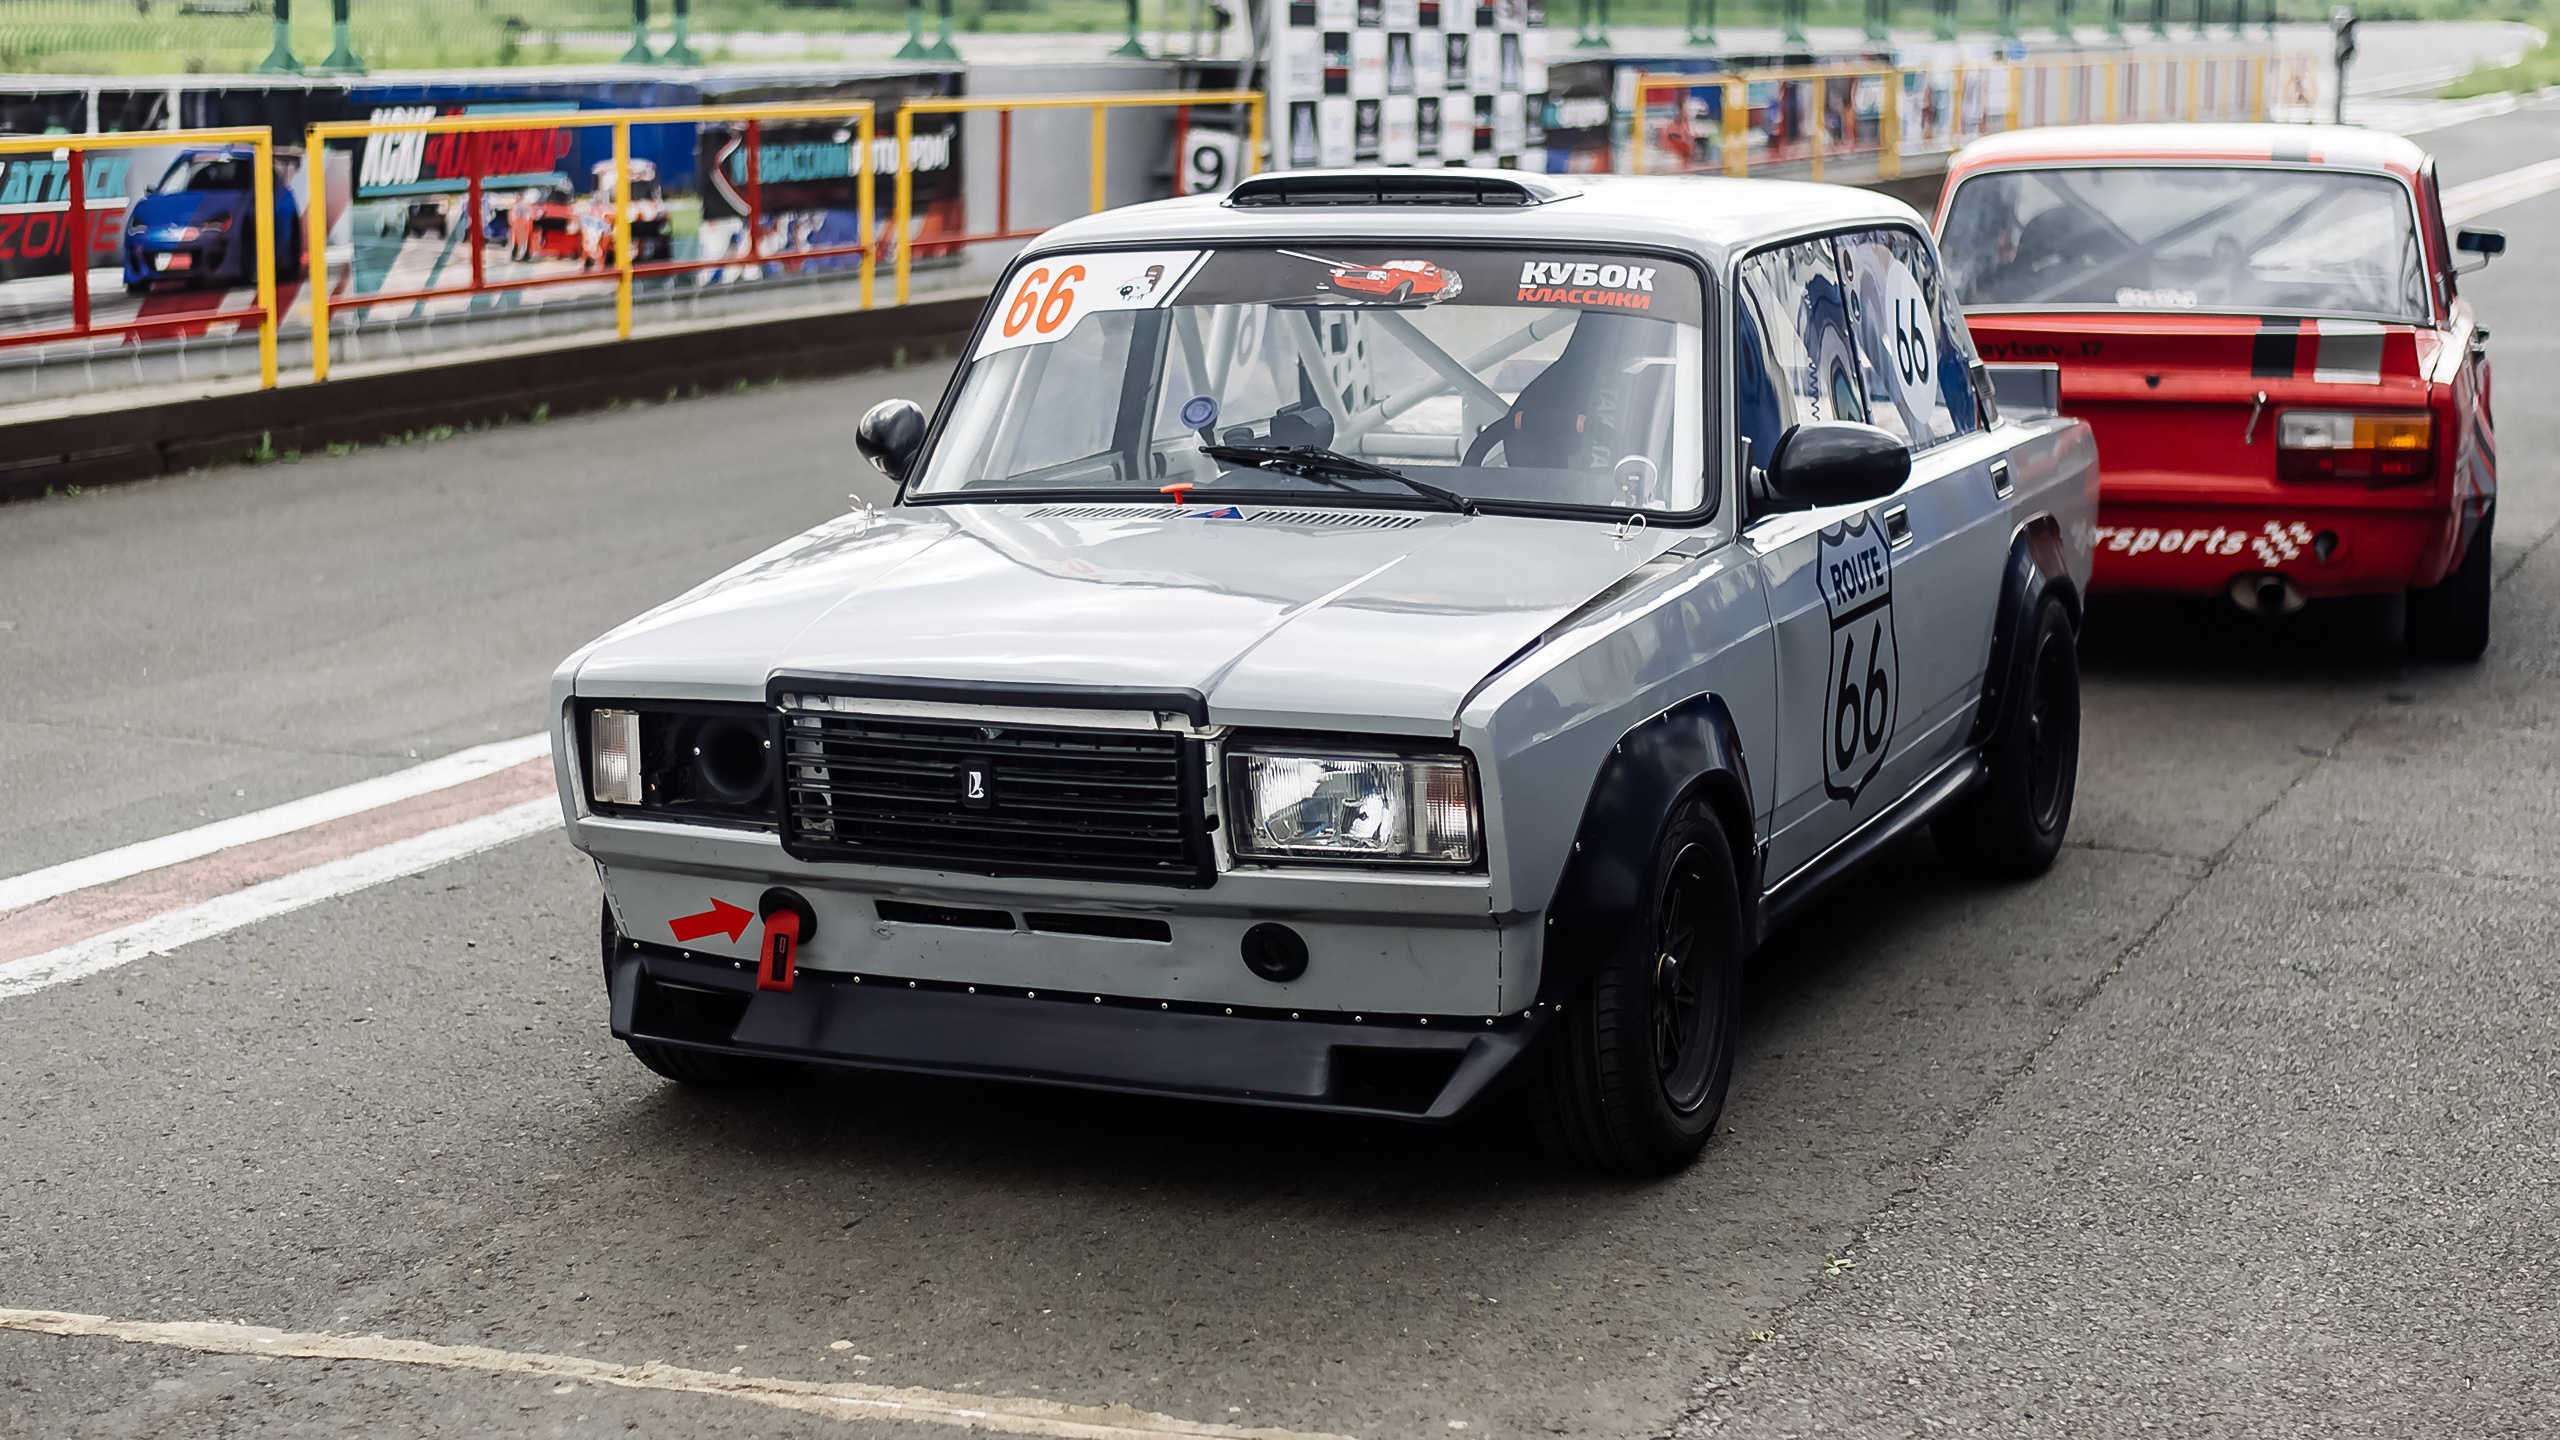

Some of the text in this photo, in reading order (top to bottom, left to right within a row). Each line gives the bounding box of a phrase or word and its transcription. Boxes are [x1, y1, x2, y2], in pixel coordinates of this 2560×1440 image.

[1193, 146, 1223, 191] 9
[0, 207, 126, 258] ZONE
[1003, 264, 1086, 338] 66
[1516, 287, 1651, 310] КЛАССИКИ
[1519, 260, 1656, 291] КУБОК
[1895, 298, 1929, 387] 66
[1979, 340, 2105, 359] aytsev_17
[1589, 387, 1618, 468] TAKTA
[2094, 526, 2247, 557] rsports
[1830, 546, 1884, 606] ROUTE
[1834, 617, 1888, 772] 66
